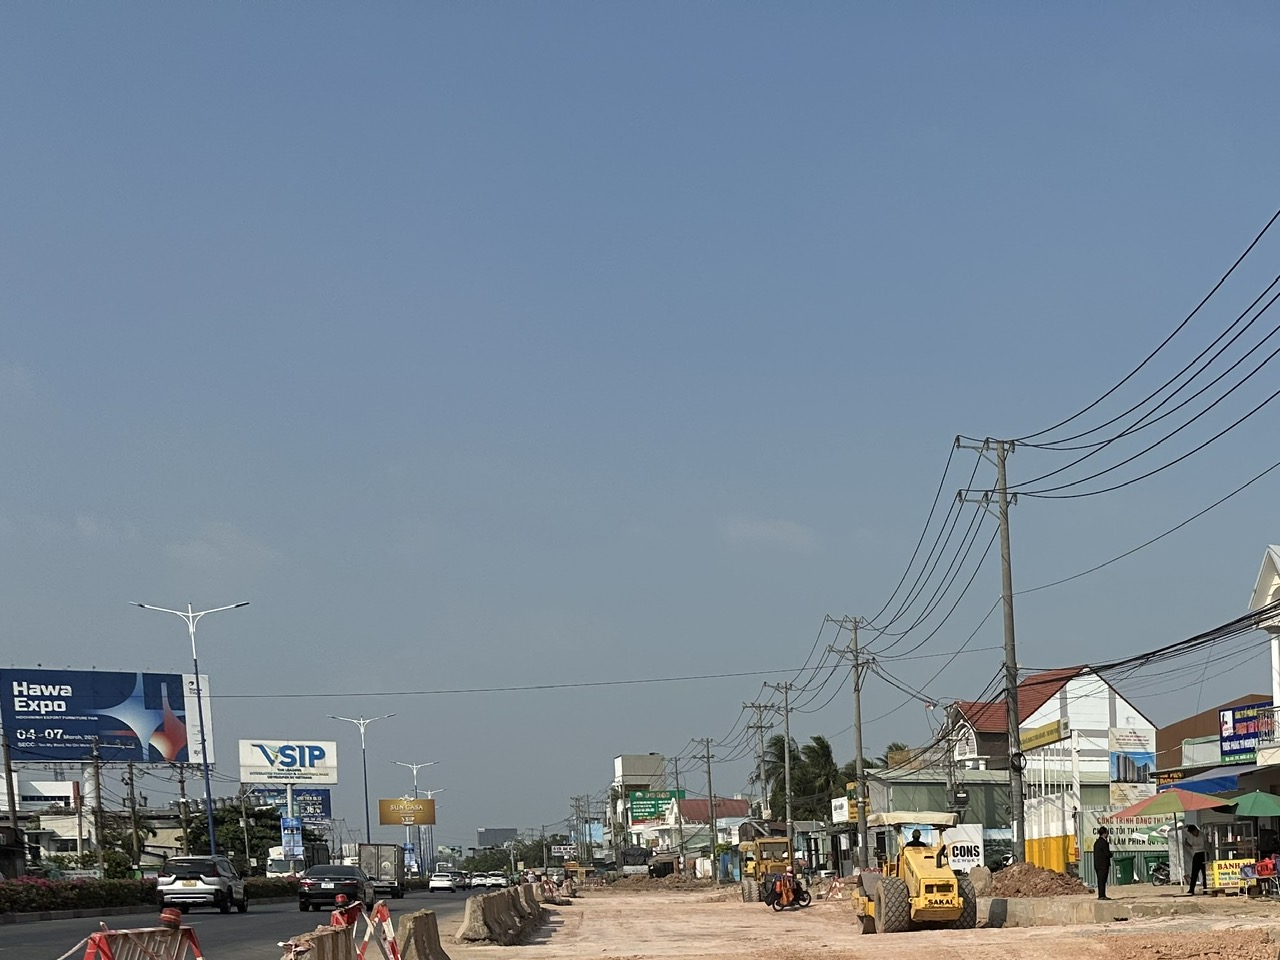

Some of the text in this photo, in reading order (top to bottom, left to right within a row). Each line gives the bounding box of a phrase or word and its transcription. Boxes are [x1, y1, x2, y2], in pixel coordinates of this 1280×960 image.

[12, 681, 73, 697] Hawa
[13, 697, 67, 715] Expo
[251, 744, 326, 768] VSIP
[1097, 815, 1114, 825] CÔNG
[1115, 826, 1126, 835] TÔI
[952, 845, 980, 858] CONS
[1217, 861, 1241, 870] BÁNH
